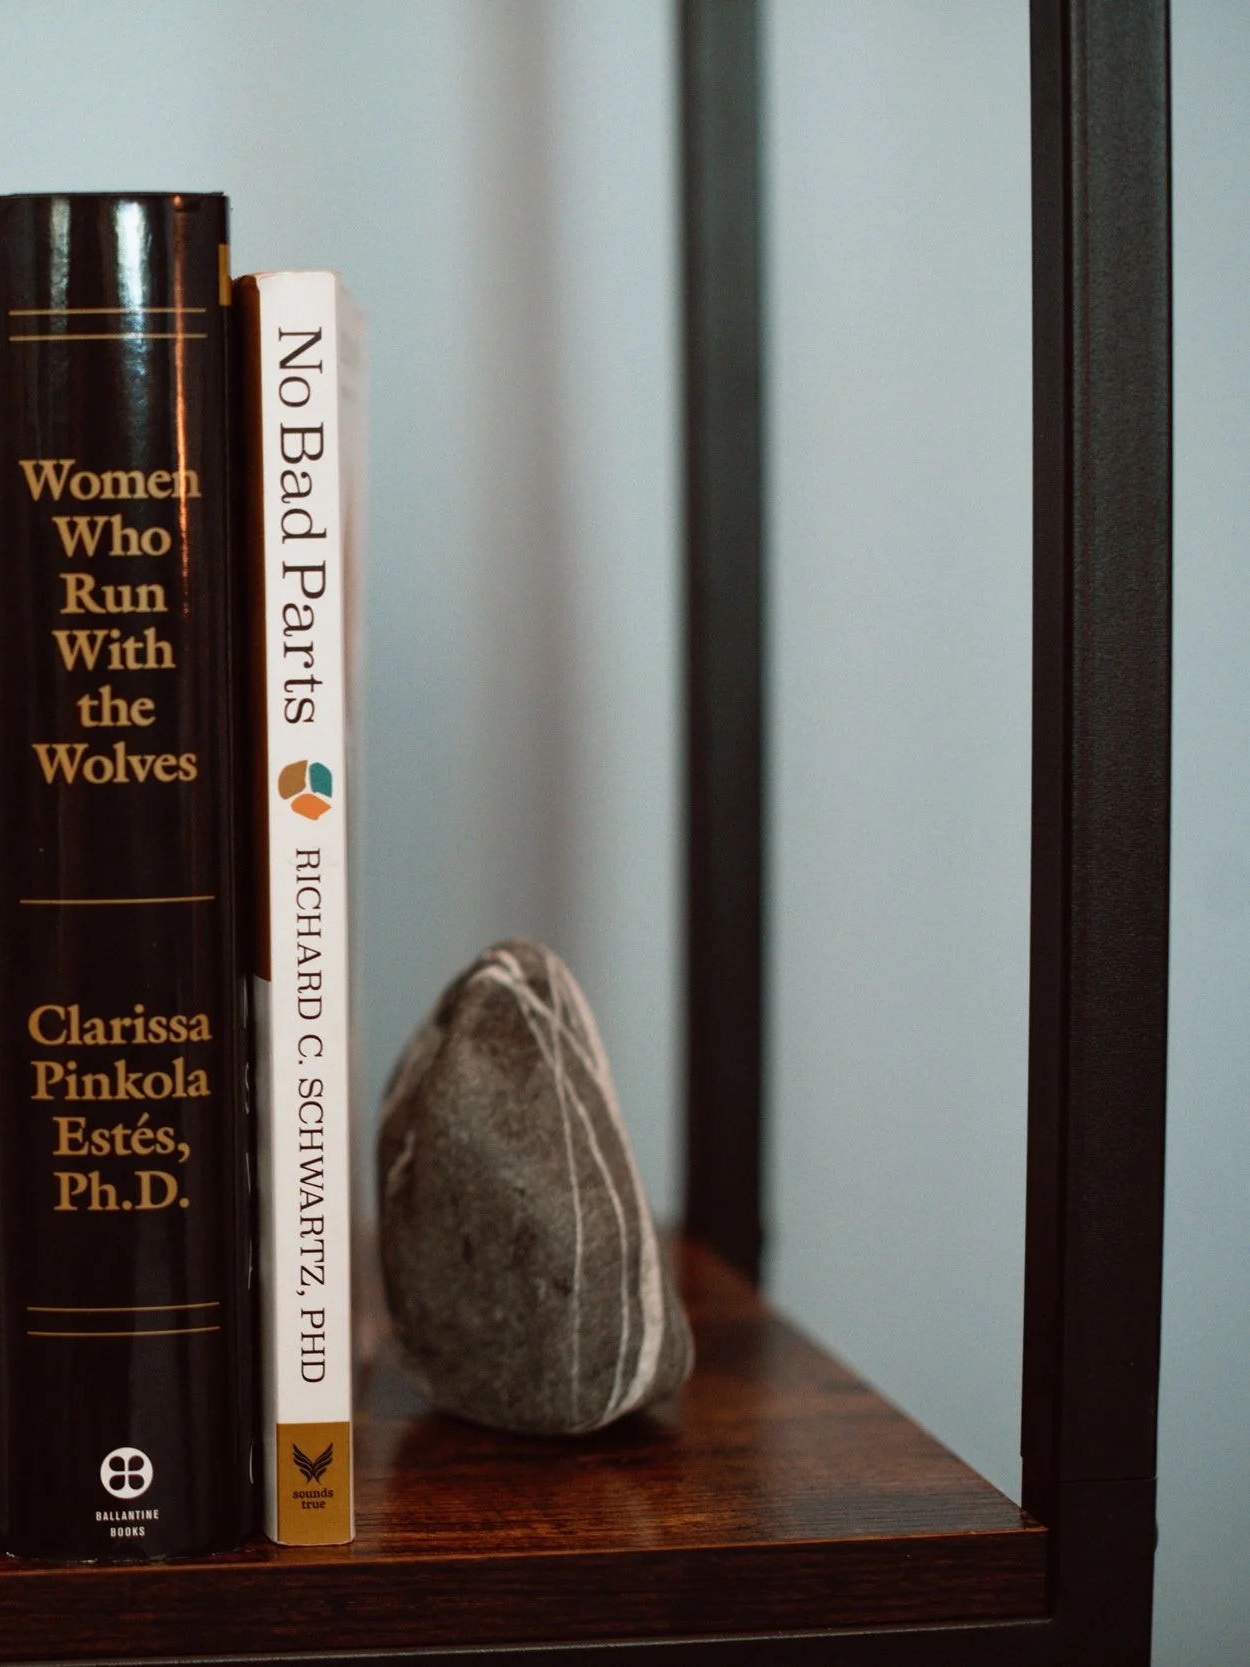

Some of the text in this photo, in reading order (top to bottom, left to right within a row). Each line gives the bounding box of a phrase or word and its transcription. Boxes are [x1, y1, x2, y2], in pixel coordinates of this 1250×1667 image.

[18, 458, 202, 502] Women
[51, 514, 173, 558] Who
[277, 325, 328, 725] No Bad Parts
[59, 573, 169, 615] Run
[51, 627, 177, 672] With
[76, 685, 157, 728] the
[31, 741, 199, 785] Wolves
[26, 1003, 212, 1047] Clarissa
[30, 1056, 211, 1102] Pinkola
[52, 1112, 191, 1163] Estés,
[295, 847, 327, 1384] RICHARD C. SCHWARTZ, PHD
[52, 1170, 190, 1213] Ph.D.
[94, 1508, 160, 1522] BALLANTINE
[292, 1487, 334, 1499] sounds
[301, 1500, 326, 1510] true
[109, 1526, 146, 1538] BOOKS
